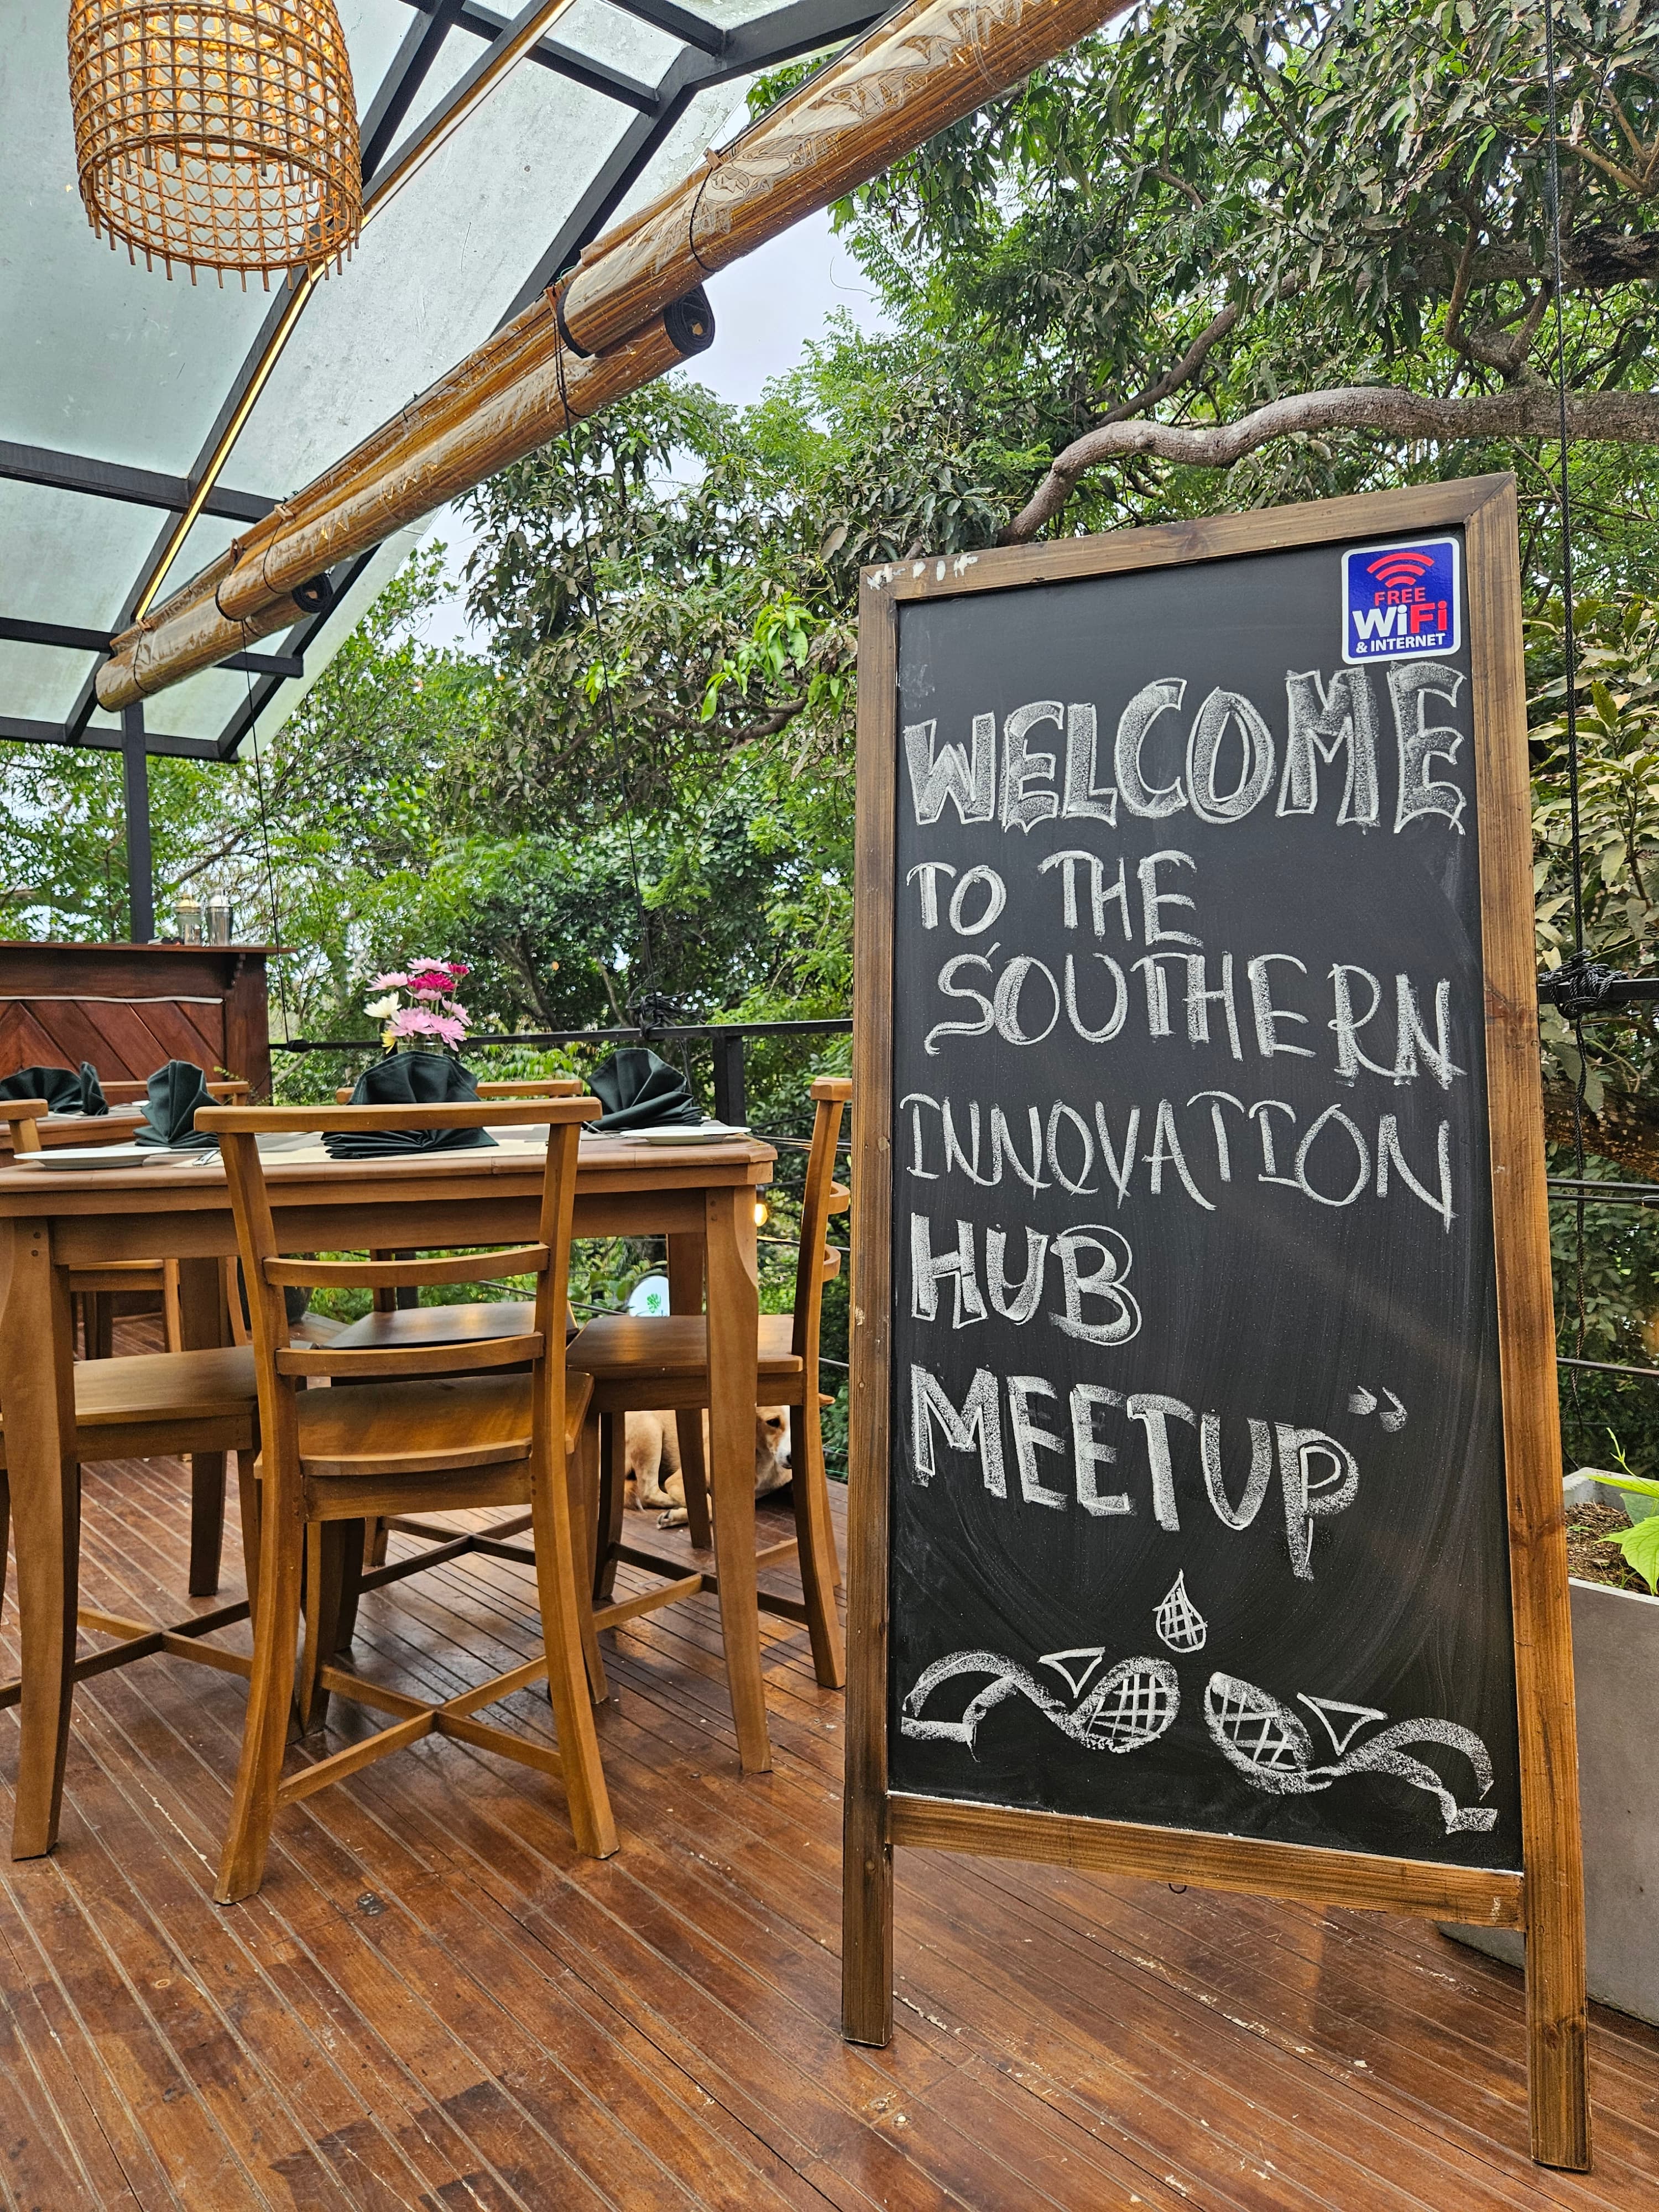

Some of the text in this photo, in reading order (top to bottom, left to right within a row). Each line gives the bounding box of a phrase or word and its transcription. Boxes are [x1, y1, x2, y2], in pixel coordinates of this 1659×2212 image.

[1352, 600, 1447, 640] WiFi
[1356, 633, 1446, 654] & INTERNET
[1374, 587, 1426, 606] FREE
[904, 661, 1467, 836] WELCOME
[907, 850, 1203, 946] TO THE
[924, 942, 1468, 1089] SOUTHERN
[900, 1091, 1458, 1233] INNOVATION
[911, 1213, 1141, 1345] HUB
